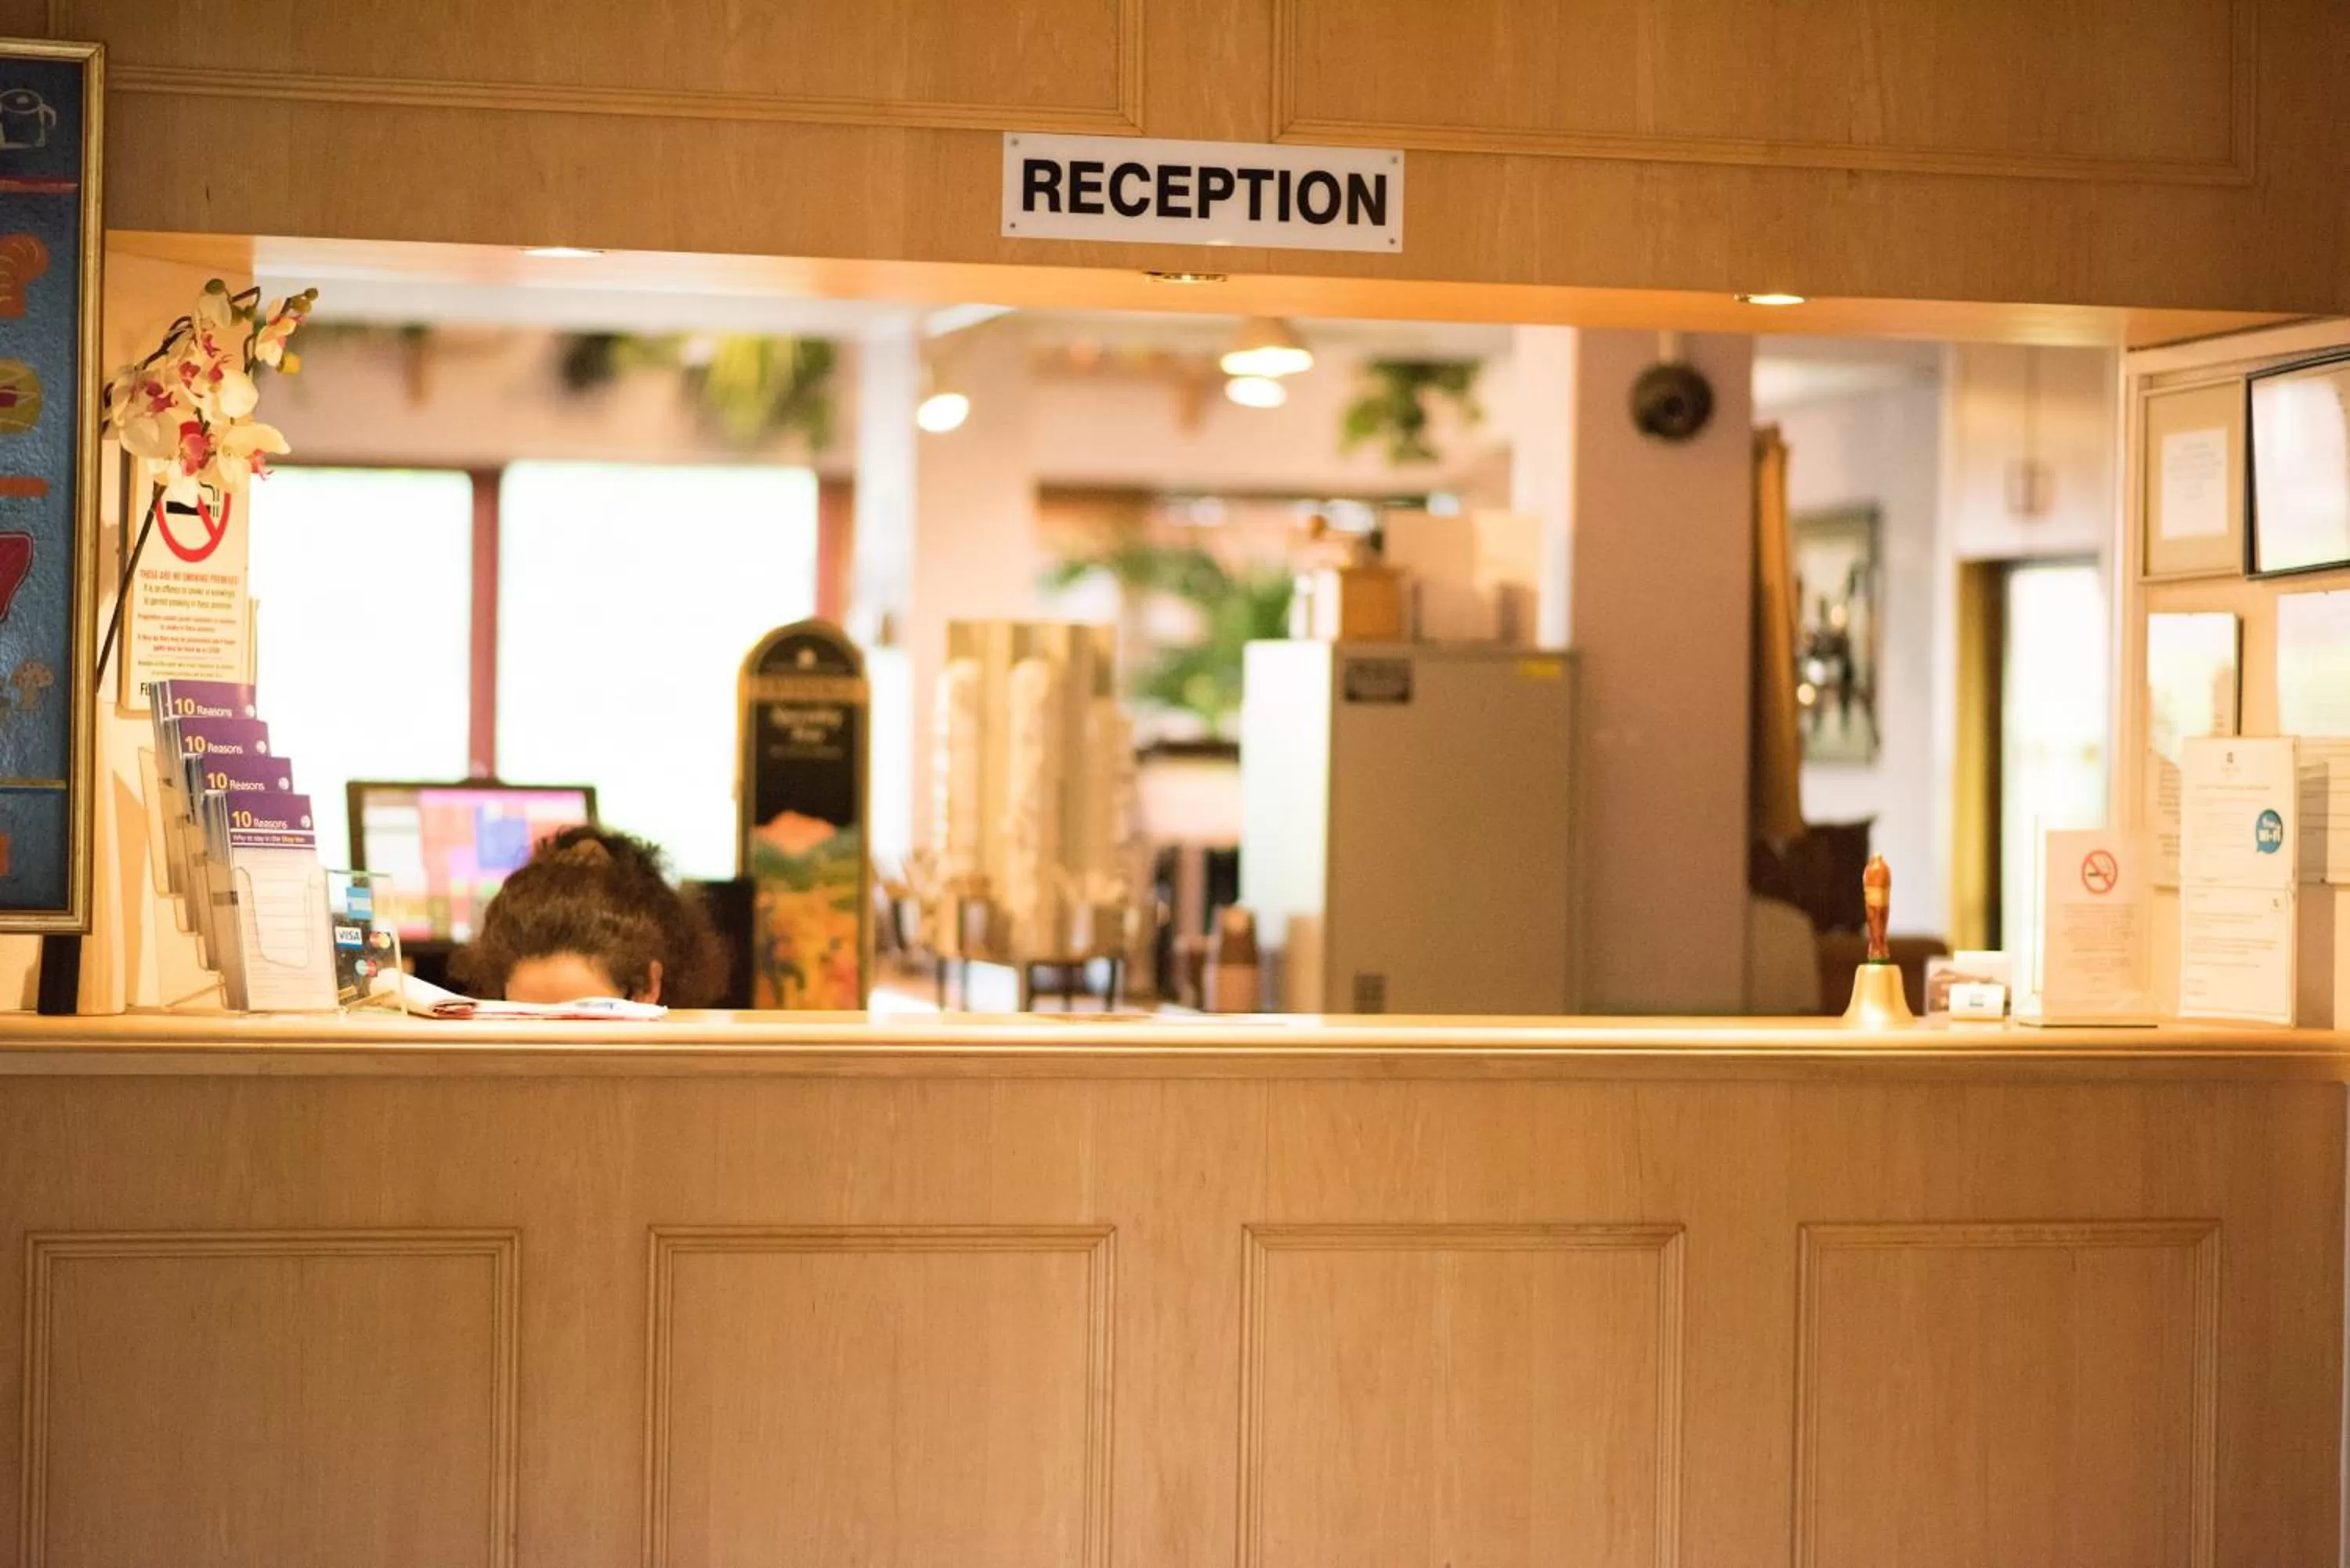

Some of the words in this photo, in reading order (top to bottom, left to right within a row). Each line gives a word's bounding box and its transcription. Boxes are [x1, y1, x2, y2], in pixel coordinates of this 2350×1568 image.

[1021, 158, 1387, 226] RECEPTION
[175, 698, 195, 715] 10
[197, 706, 233, 717] Reasons
[185, 735, 206, 753] 10
[207, 742, 243, 754] Reasons
[207, 772, 227, 789] 10
[230, 779, 266, 790] Reasons
[232, 811, 251, 828] 10
[253, 818, 288, 829] Reasons
[339, 930, 360, 941] VISA
